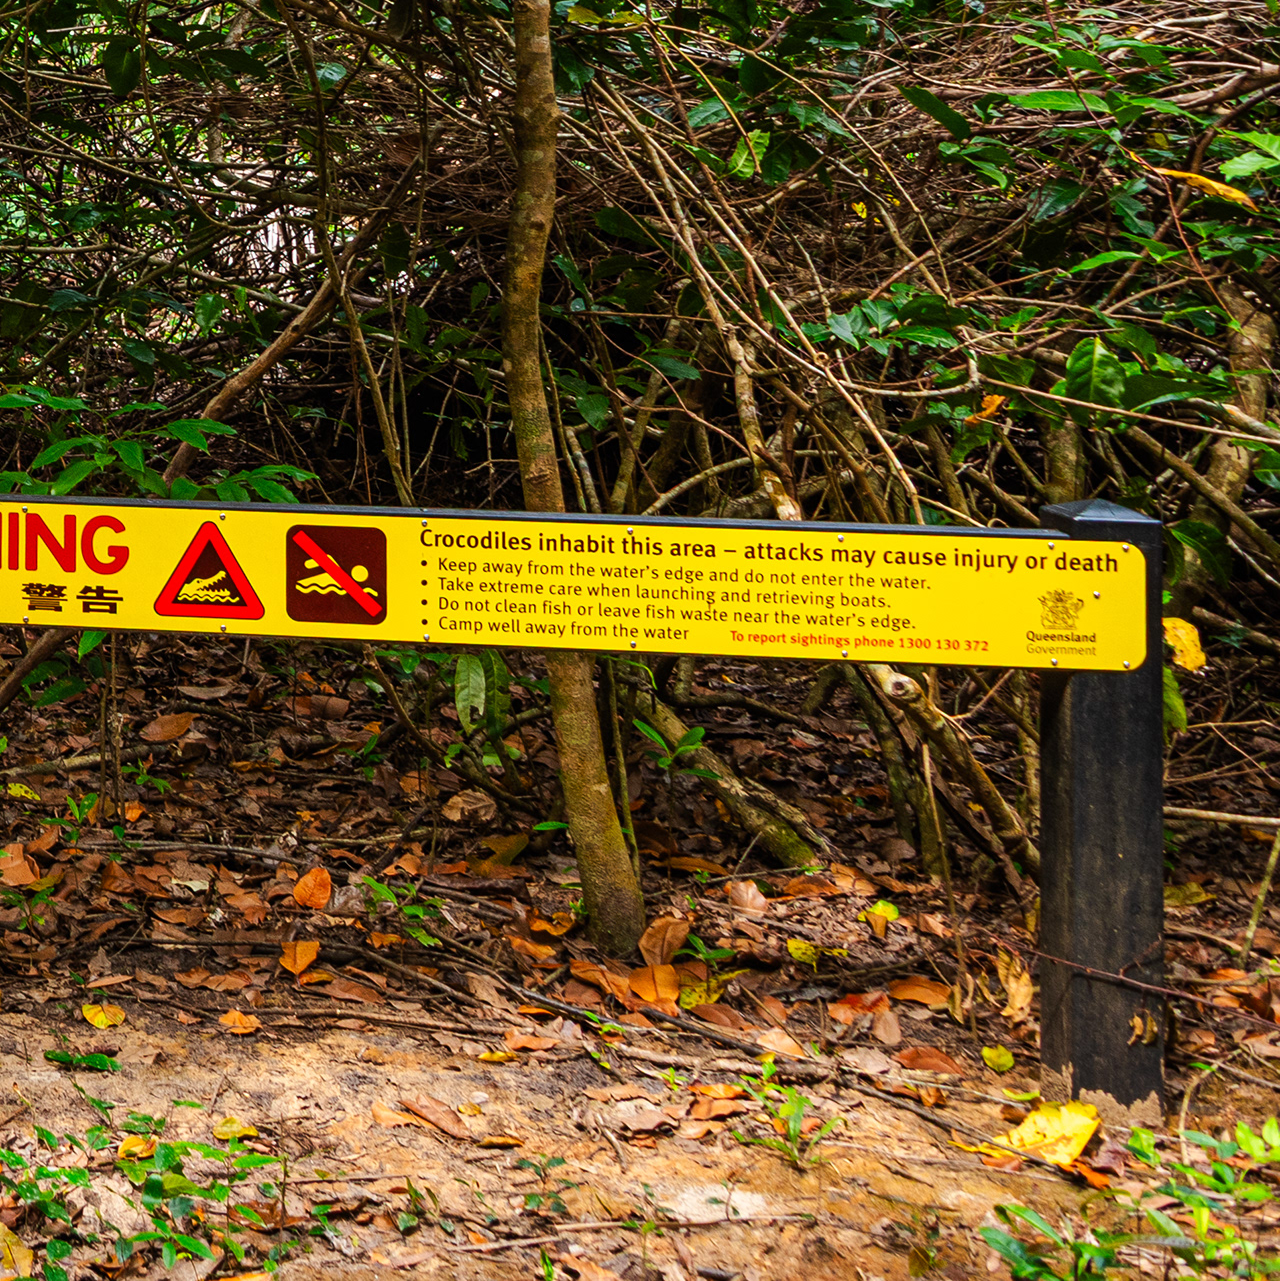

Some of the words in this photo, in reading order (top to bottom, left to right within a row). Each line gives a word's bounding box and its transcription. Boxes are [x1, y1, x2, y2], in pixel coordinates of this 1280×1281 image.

[420, 529, 532, 552] Crocodiles
[538, 532, 615, 553] inhabit
[621, 536, 663, 556] this
[669, 542, 716, 557] area
[744, 542, 823, 561] attacks
[831, 548, 876, 568] may
[883, 550, 946, 566] cause
[954, 547, 1018, 573] injury
[1025, 555, 1048, 569] or
[1054, 551, 1118, 572] death
[438, 557, 477, 575] Keep
[482, 562, 523, 578] away
[527, 559, 563, 575] from
[569, 562, 595, 576] the
[664, 566, 703, 583] edge
[709, 568, 738, 582] and
[744, 568, 764, 583] do
[770, 572, 795, 584] not
[801, 573, 843, 586] enter
[849, 572, 875, 587] the
[880, 576, 930, 589] water.
[21, 582, 124, 615] 警告
[437, 576, 473, 591] Take
[479, 580, 543, 594] extreme
[548, 584, 582, 595] care
[587, 582, 630, 597] when
[636, 584, 715, 603] launching
[720, 588, 750, 602] and
[756, 590, 835, 609] retrieving
[840, 592, 890, 607] boats.
[438, 596, 459, 610] Do
[464, 599, 490, 612] not
[495, 598, 536, 613] clean
[542, 599, 571, 614] fish
[577, 605, 593, 616] or
[598, 602, 640, 618] leave
[645, 603, 674, 619] fish
[680, 609, 727, 621] waste
[733, 611, 769, 623] near
[774, 609, 800, 624] the
[870, 613, 915, 631] edge.
[438, 615, 483, 634] Camp
[487, 618, 520, 633] well
[525, 622, 565, 638] away
[570, 620, 607, 636] from
[612, 623, 638, 637] the
[643, 626, 689, 639] water
[730, 630, 744, 641] To
[748, 633, 786, 645] report
[790, 632, 850, 648] sightings
[854, 635, 894, 648] phone
[899, 637, 931, 649] 1300
[936, 638, 960, 650] 130
[964, 639, 988, 651] 372
[1026, 630, 1097, 643] Queensland
[1026, 643, 1097, 656] Government
